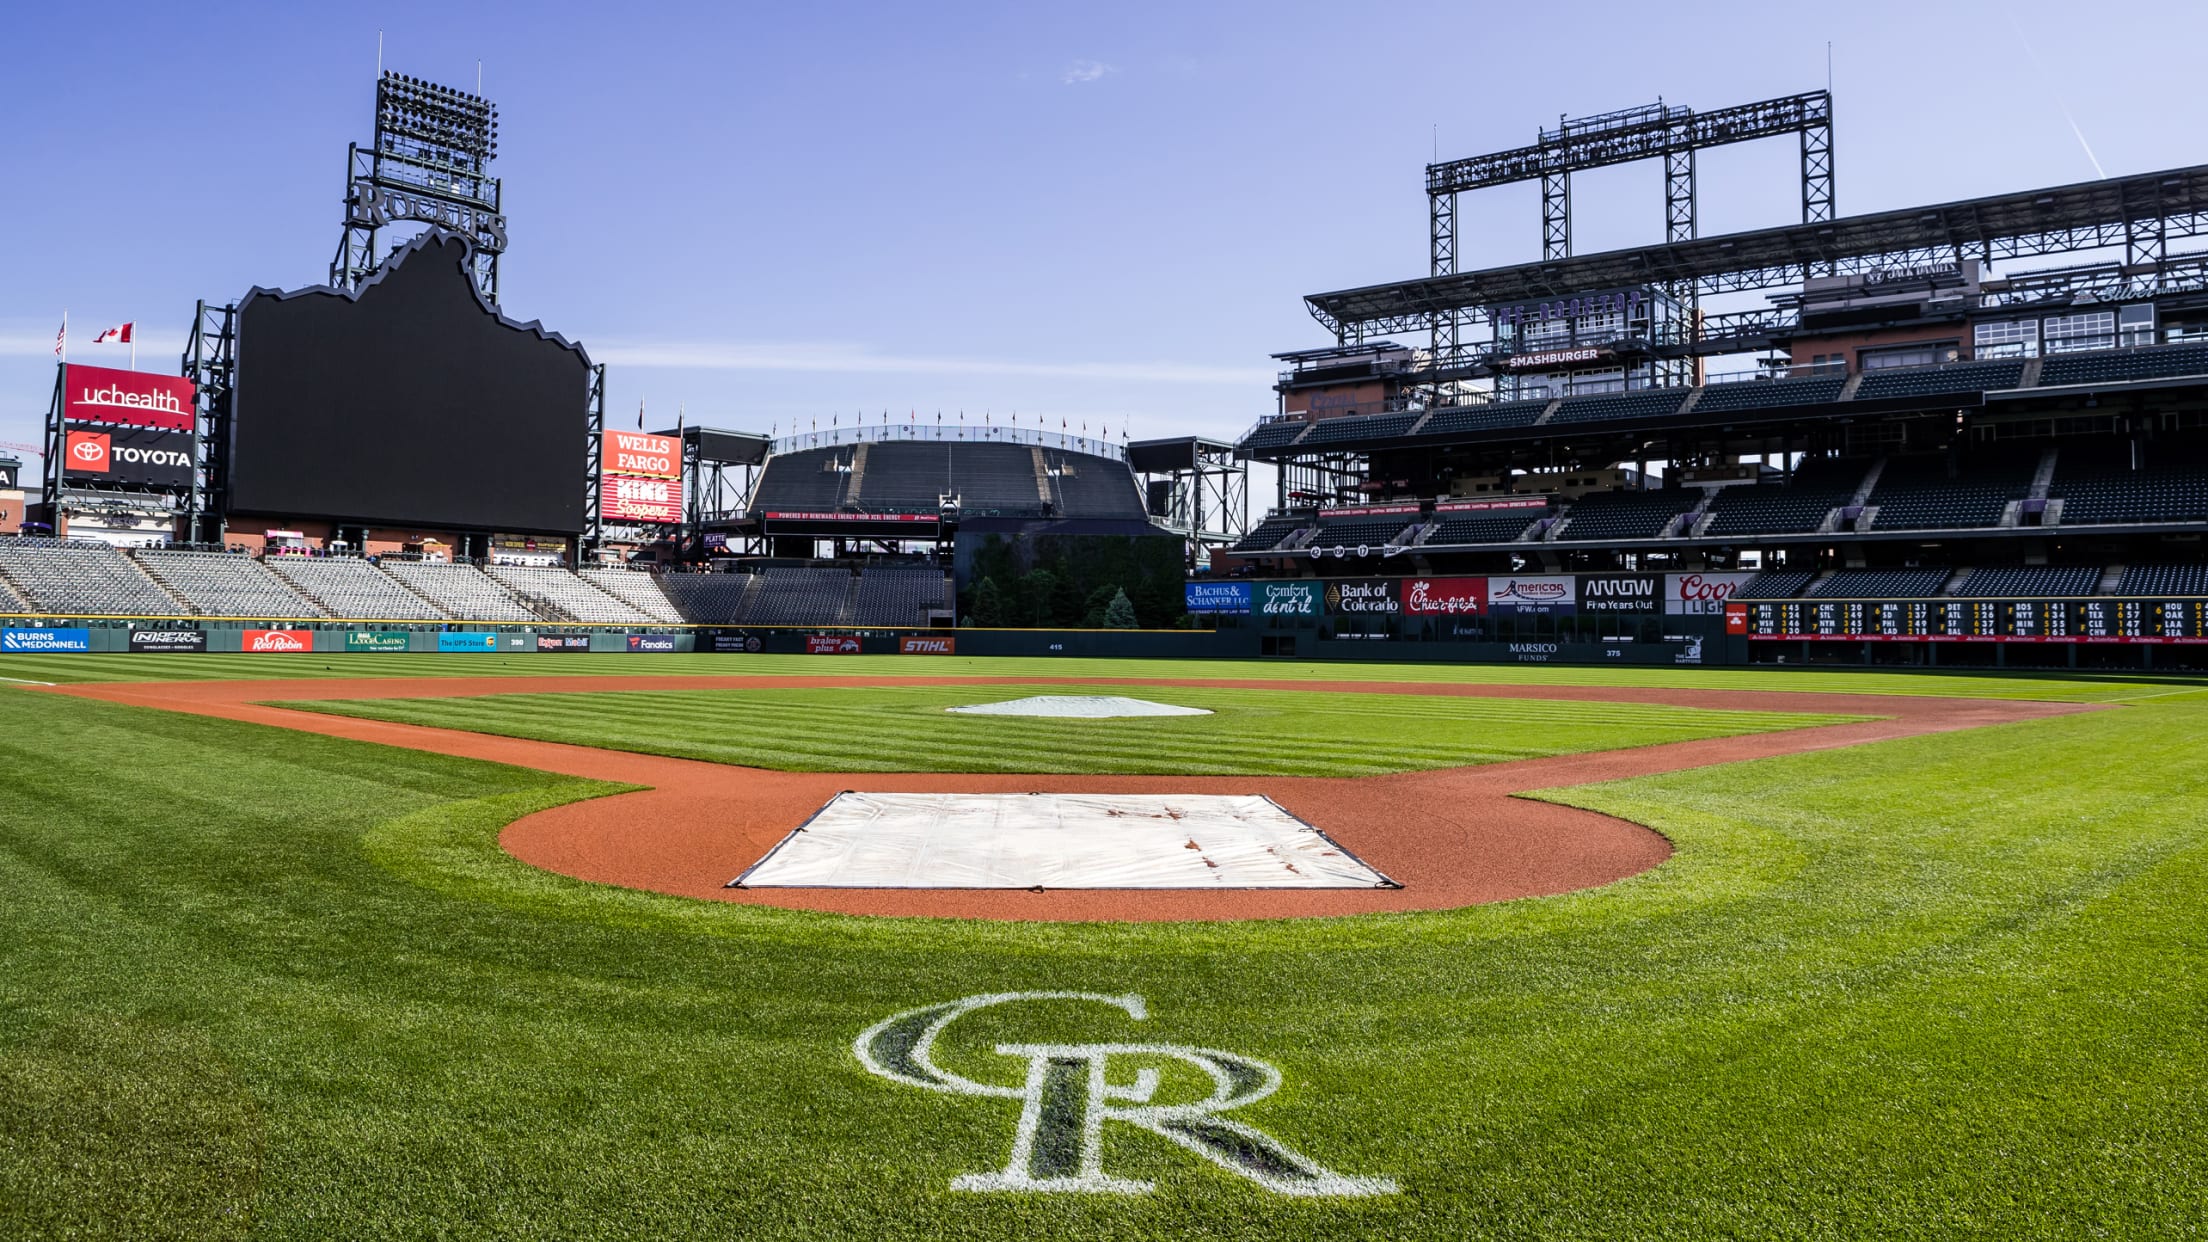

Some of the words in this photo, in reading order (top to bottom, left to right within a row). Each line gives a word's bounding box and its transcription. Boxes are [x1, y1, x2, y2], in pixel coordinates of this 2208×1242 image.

[348, 184, 508, 252] ROCKIES
[1887, 267, 1914, 279] JACK
[2100, 285, 2156, 302] Silver
[1487, 304, 1525, 327] THE
[1539, 291, 1641, 321] ROOFTOP
[1510, 349, 1598, 367] SMASHBURGER
[84, 384, 180, 412] uchealth
[617, 434, 670, 454] WELLS
[112, 446, 192, 467] TOYOTA
[617, 453, 670, 472] FARGO
[617, 480, 668, 502] KING
[616, 499, 669, 519] Soopers
[1195, 586, 1230, 597] BACHUS
[1230, 586, 1240, 597] &
[1266, 584, 1309, 597] Comfort
[1341, 583, 1372, 597] Bank
[1374, 582, 1388, 597] of
[1585, 579, 1654, 596] ARROW
[1680, 575, 1736, 601] Coor
[1186, 595, 1232, 606] SCHANKER
[1608, 601, 1634, 610] Years
[1692, 601, 1724, 613] LIGH
[1883, 603, 1898, 611] MIA
[1948, 603, 1960, 611] DET
[2016, 603, 2031, 611] BOS
[2089, 603, 2099, 611] KC
[2166, 602, 2181, 611] HOU
[1820, 611, 1830, 619] STL
[1883, 611, 1892, 619] SD
[1948, 611, 1960, 619] ATL
[2016, 611, 2032, 619] NYY
[2089, 611, 2103, 619] TEX
[2165, 611, 2183, 619] OAK
[1759, 619, 1773, 627] WSH
[1948, 620, 1956, 628] SF
[2016, 620, 2033, 628] MIN
[2089, 620, 2102, 628] CLE
[2165, 620, 2182, 628] LAA
[1820, 627, 1832, 635] ARI
[1884, 627, 1897, 635] LAD
[1948, 628, 1961, 636] BAL
[2017, 628, 2025, 636] TB
[2089, 628, 2106, 636] CHW
[2166, 629, 2181, 637] SEA
[17, 633, 54, 641] BURNS
[375, 633, 406, 645] CASINO
[810, 637, 841, 645] brakes
[252, 637, 275, 650] Red
[273, 637, 303, 650] Robin
[565, 637, 588, 647] Mobil
[641, 639, 673, 650] Fanatics
[904, 641, 949, 652] STIHL
[815, 645, 834, 653] plus
[1509, 643, 1557, 653] MARSICO
